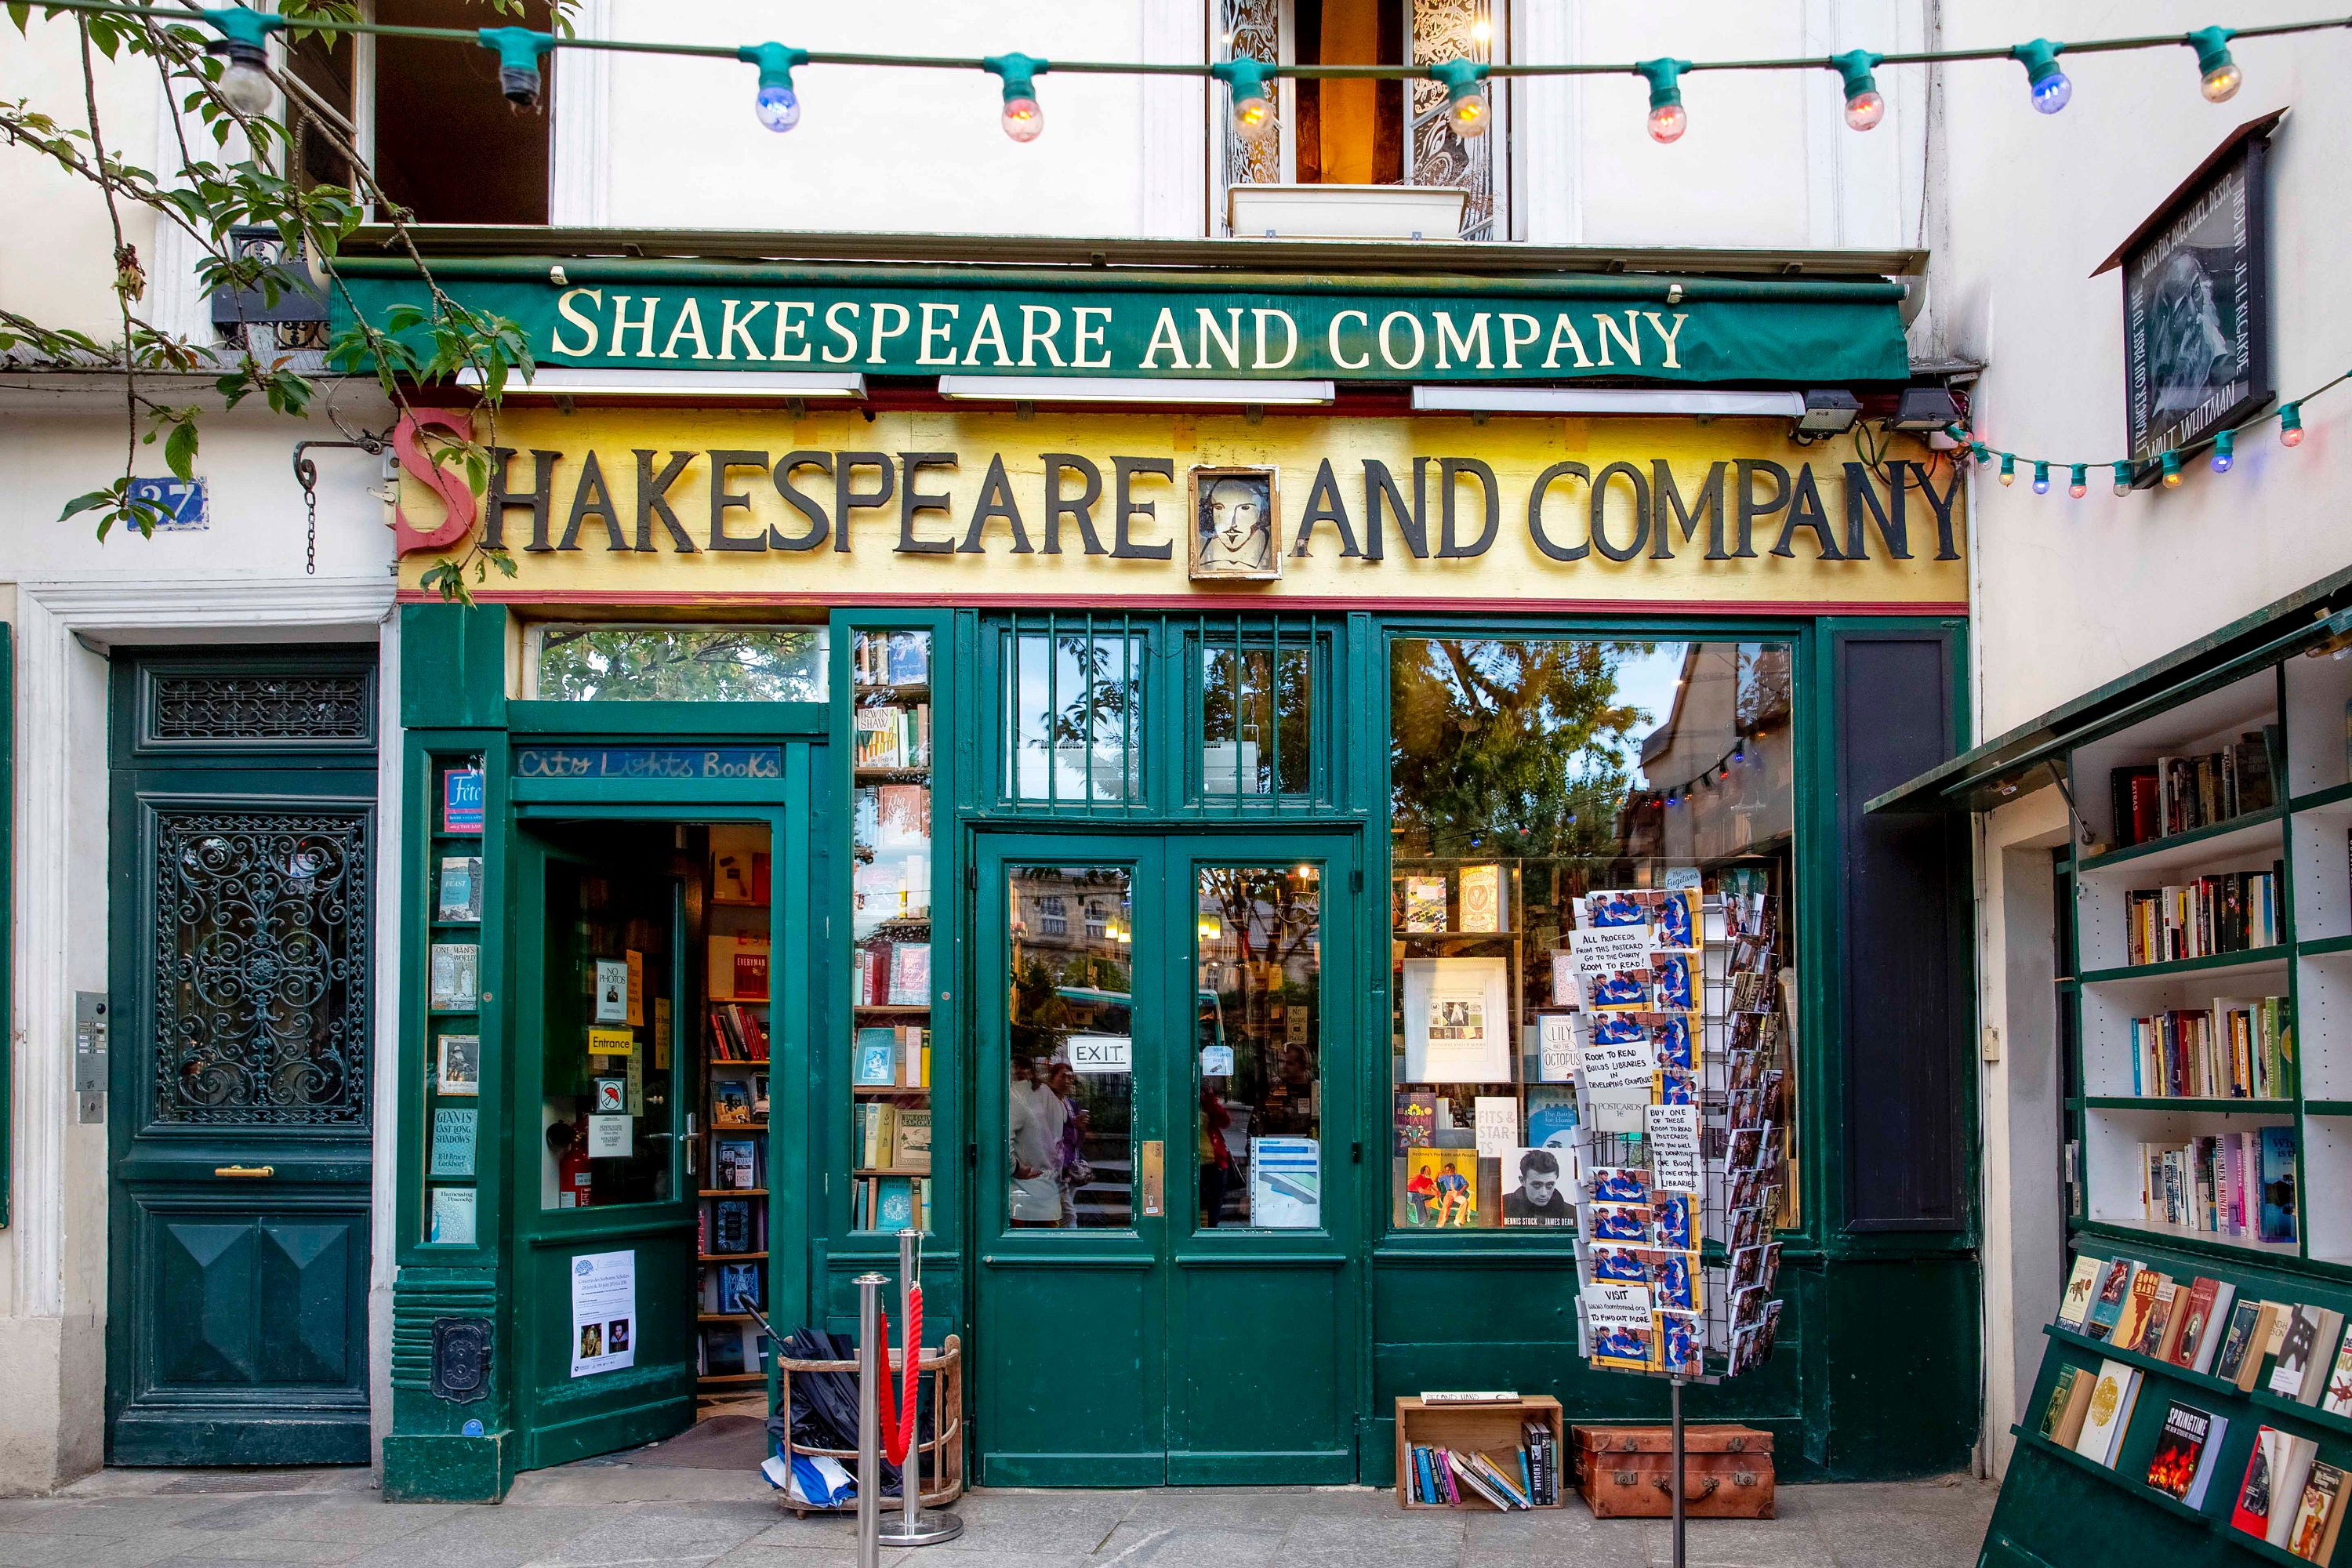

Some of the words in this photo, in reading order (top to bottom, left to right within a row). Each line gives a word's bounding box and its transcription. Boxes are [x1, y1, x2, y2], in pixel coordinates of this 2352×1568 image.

[2142, 246, 2158, 278] SAIS
[2157, 233, 2170, 261] PAS
[2187, 199, 2208, 233] QUEL
[2209, 173, 2232, 213] DESIR
[2132, 286, 2143, 306] NE
[2132, 309, 2144, 330] TU
[551, 289, 1112, 369] SHAKESPEARE
[1141, 307, 1298, 371] AND
[1329, 310, 1689, 371] COMPANY
[2133, 326, 2147, 362] PASSE
[2134, 365, 2147, 387] QUI
[2134, 387, 2148, 453] ETRANGER
[2147, 425, 2177, 466] WALT
[2180, 379, 2235, 444] WHITMAN
[394, 407, 1173, 560] SHAKESPEARE
[1288, 457, 1499, 561] AND
[1529, 459, 1962, 561] COMPANY
[861, 709, 888, 719] IRWIN
[861, 718, 888, 730] SHAW
[519, 750, 592, 776] City
[1667, 873, 1699, 889] Fugitives
[1583, 935, 1597, 944] ALL
[1581, 963, 1602, 971] ROOM
[1620, 958, 1644, 969] READ!
[599, 975, 626, 984] PHOTOS
[1552, 1026, 1571, 1040] LILY
[593, 1036, 630, 1049] Entrance
[1545, 1053, 1581, 1065] OCTOPUS
[1584, 1052, 1604, 1061] ROOM
[1617, 1049, 1636, 1058] READ
[1586, 1063, 1609, 1073] BUILDS
[1612, 1059, 1646, 1070] LIBRARIES
[437, 1111, 472, 1123] GIANTS
[1479, 1111, 1504, 1123] FITS
[1506, 1111, 1515, 1123] &
[454, 1125, 470, 1134] LONG
[1479, 1126, 1515, 1138] STAR-
[1479, 1142, 1493, 1154] TS
[2220, 1189, 2228, 1218] KUNZRU
[1504, 1217, 1521, 1225] DENNIS
[1522, 1217, 1537, 1225] STOCK
[1544, 1217, 1560, 1225] JAMES
[1561, 1217, 1573, 1225] DEAN
[1605, 1290, 1628, 1300] VISIT
[2168, 1407, 2209, 1436] SPRINGTIME
